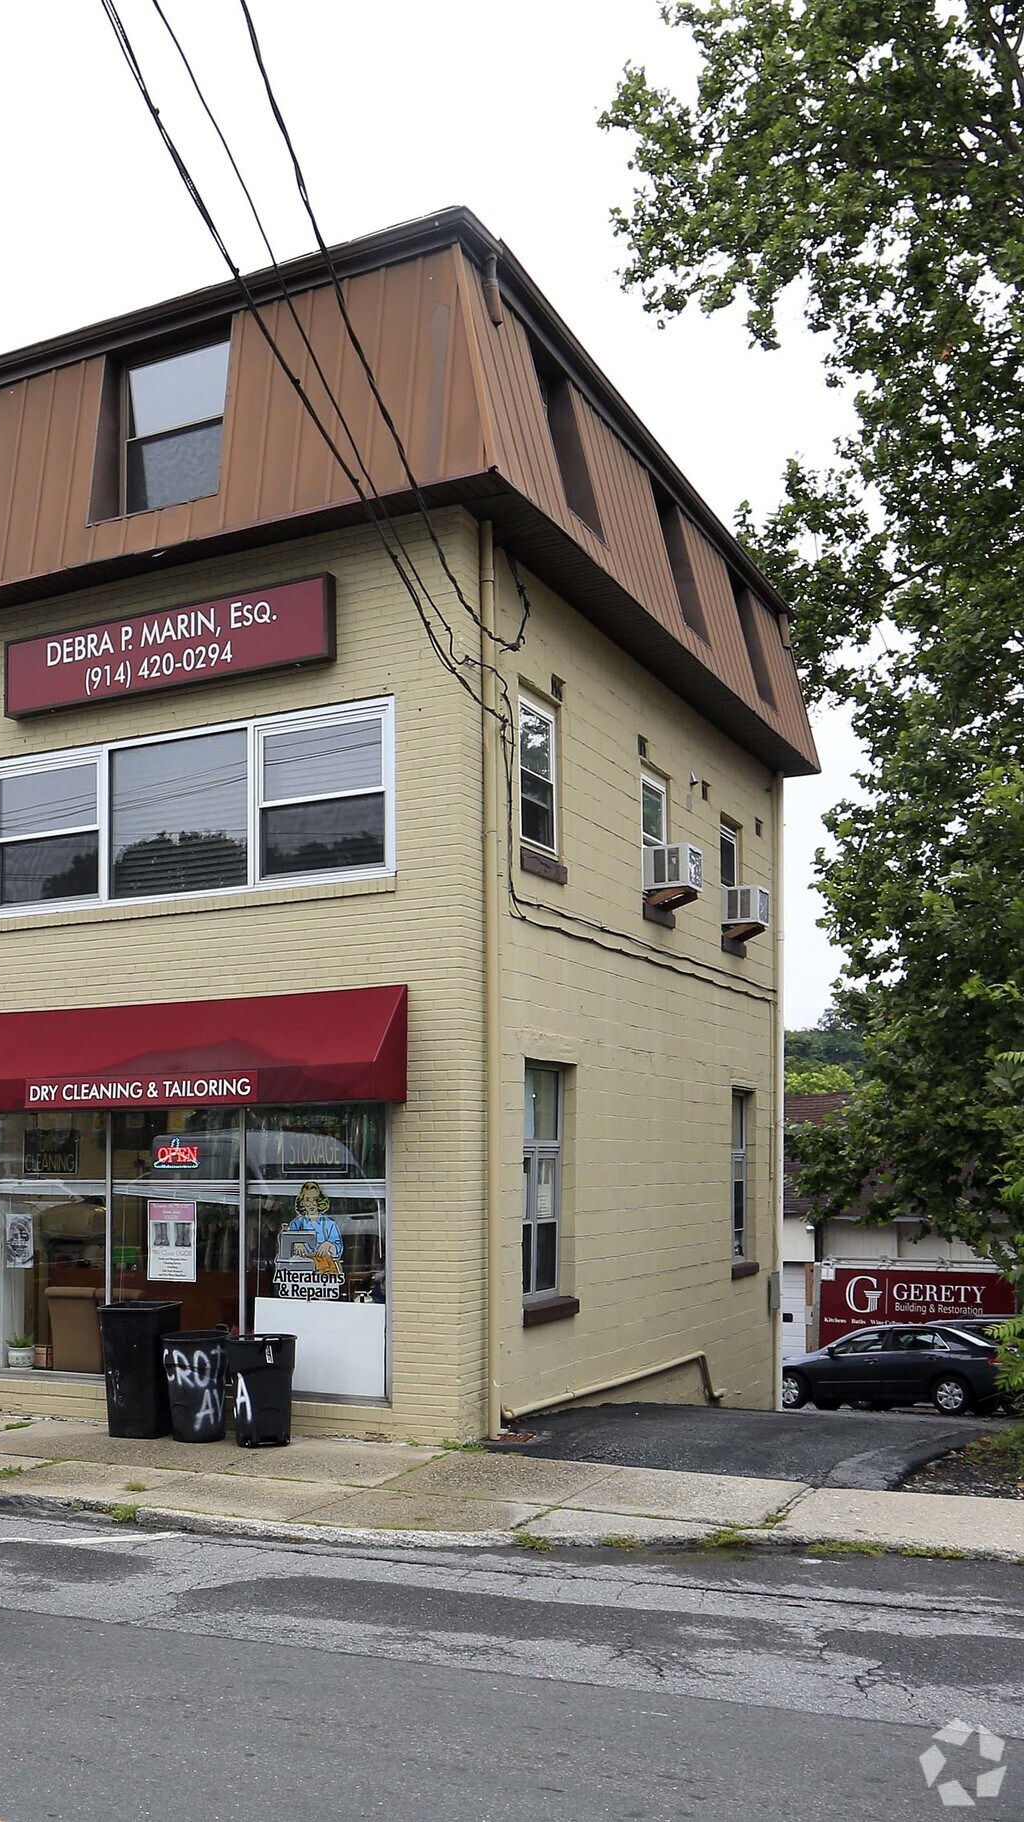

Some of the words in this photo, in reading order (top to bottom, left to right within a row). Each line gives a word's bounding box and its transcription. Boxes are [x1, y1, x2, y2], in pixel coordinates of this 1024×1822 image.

[46, 630, 114, 667] DEBRA
[121, 626, 134, 652] P.
[140, 607, 222, 648] MARIN,
[229, 601, 278, 630] ESQ.
[84, 660, 132, 696] (914)
[137, 640, 233, 680] 420-0294
[29, 1084, 58, 1102] DRY
[62, 1081, 143, 1101] CLEANING
[146, 1081, 158, 1099] &
[163, 1077, 251, 1099] TAILORING
[157, 1146, 198, 1164] OPEN
[289, 1133, 341, 1165] STORAGE
[24, 1153, 75, 1172] CLEANING
[274, 1269, 345, 1286] Alterations
[280, 1284, 290, 1297] &
[291, 1283, 339, 1299] Repairs
[892, 1283, 986, 1304] GERETY
[894, 1302, 927, 1315] Building
[929, 1305, 936, 1313] &
[937, 1305, 984, 1315] Restoration
